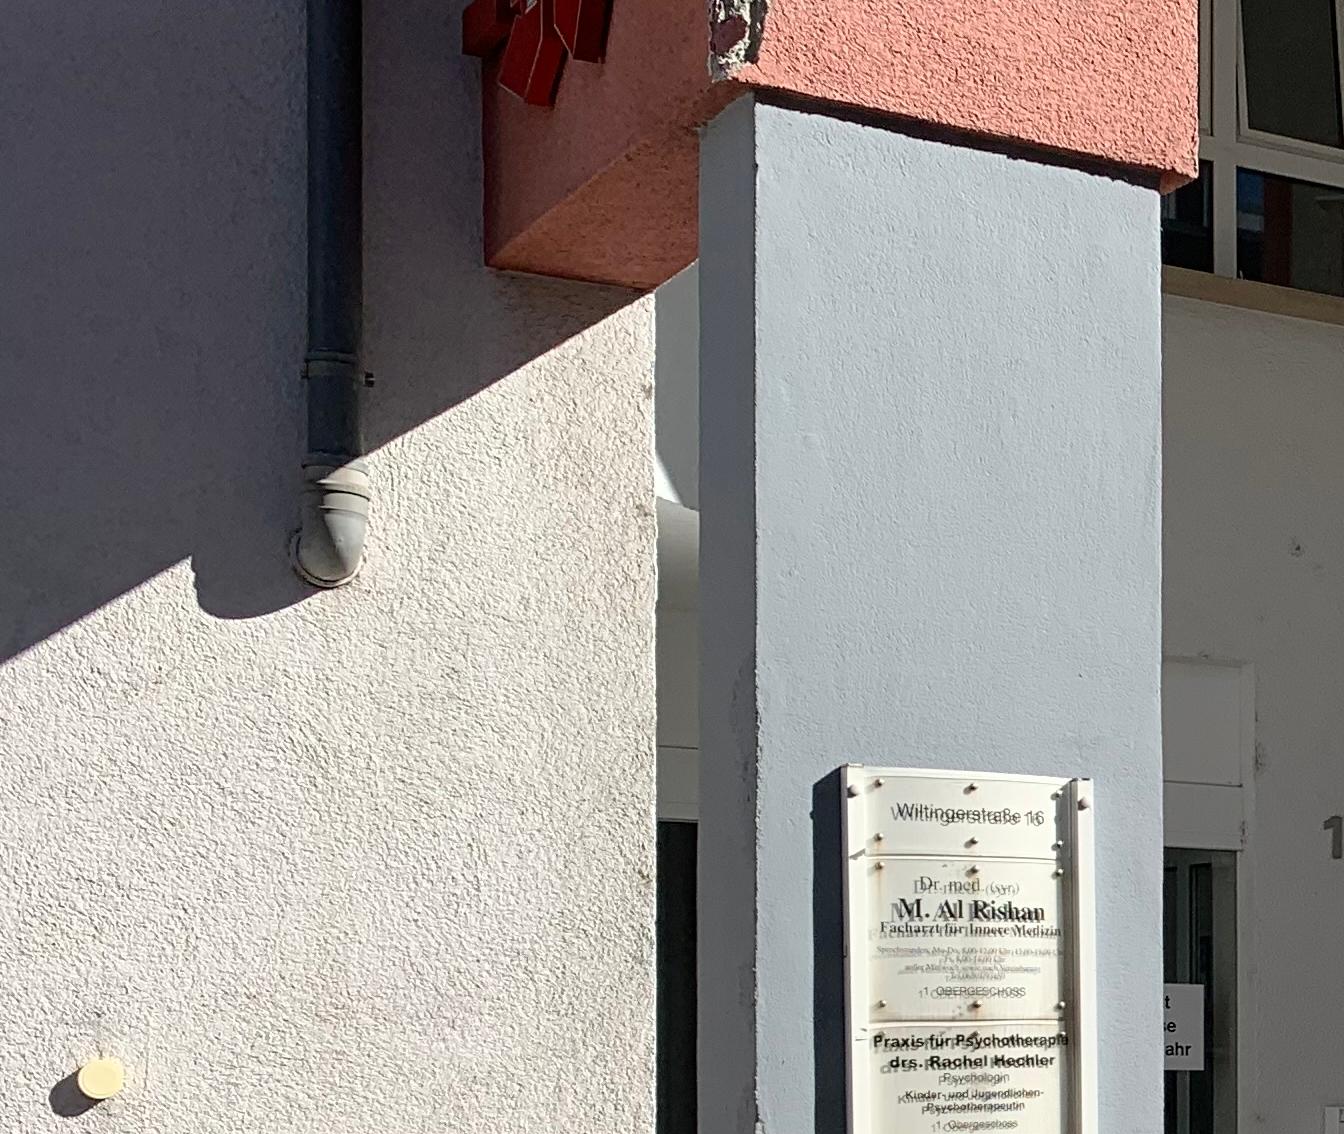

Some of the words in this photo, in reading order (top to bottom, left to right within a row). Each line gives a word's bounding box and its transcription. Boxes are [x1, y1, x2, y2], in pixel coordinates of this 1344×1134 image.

[896, 803, 1021, 823] Wiltingerstraße
[1028, 811, 1045, 824] 16
[898, 898, 931, 919] M.
[938, 899, 964, 920] Al
[972, 899, 1046, 921] Rishan
[880, 921, 941, 935] Facharzt
[945, 922, 965, 936] für
[969, 923, 1010, 937] Innere
[1014, 924, 1062, 938] Medizin
[873, 1034, 925, 1048] Praxis
[930, 1034, 951, 1048] für
[956, 1033, 1069, 1051] Psychotherapie
[889, 1055, 924, 1069] drs.
[930, 1054, 988, 1069] Rachel
[994, 1053, 1056, 1067] Hechler
